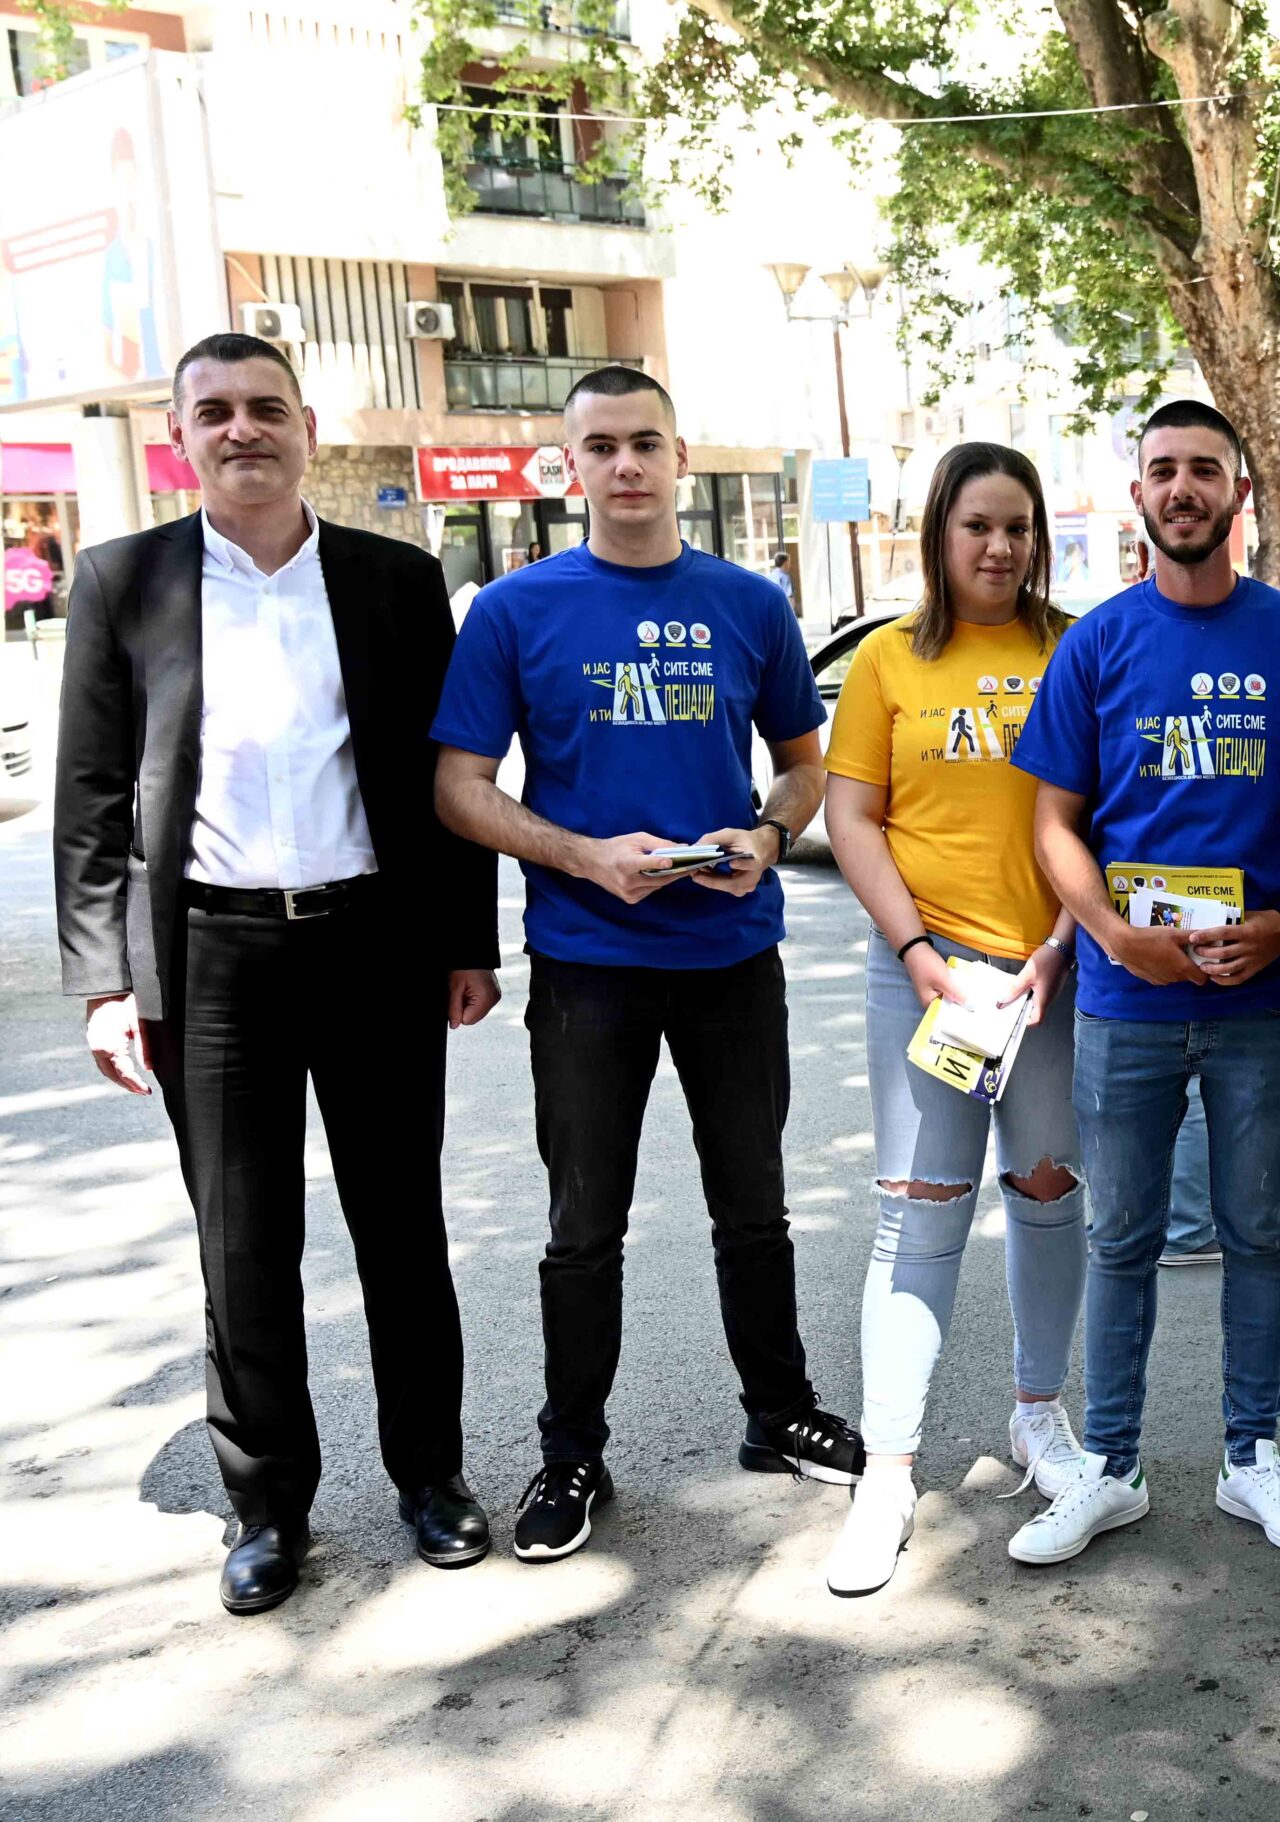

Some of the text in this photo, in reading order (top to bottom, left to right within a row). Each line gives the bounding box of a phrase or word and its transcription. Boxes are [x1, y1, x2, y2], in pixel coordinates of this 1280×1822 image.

[5, 568, 43, 594] 5G
[583, 663, 591, 675] И
[663, 661, 714, 677] СИТЕ СМЕ
[664, 684, 715, 728] ПЕШАЦИ
[1001, 706, 1027, 717] СИТЕ
[589, 709, 612, 722] И ТИ
[920, 709, 927, 718] И
[1136, 717, 1142, 730] И
[1216, 714, 1266, 730] СИТЕ СМЕ
[921, 748, 944, 761] И ТИ
[1216, 737, 1266, 784] ПЕШАЦИ
[1139, 764, 1161, 777] И ТИ
[1187, 885, 1235, 896] СИТЕ СМЕ
